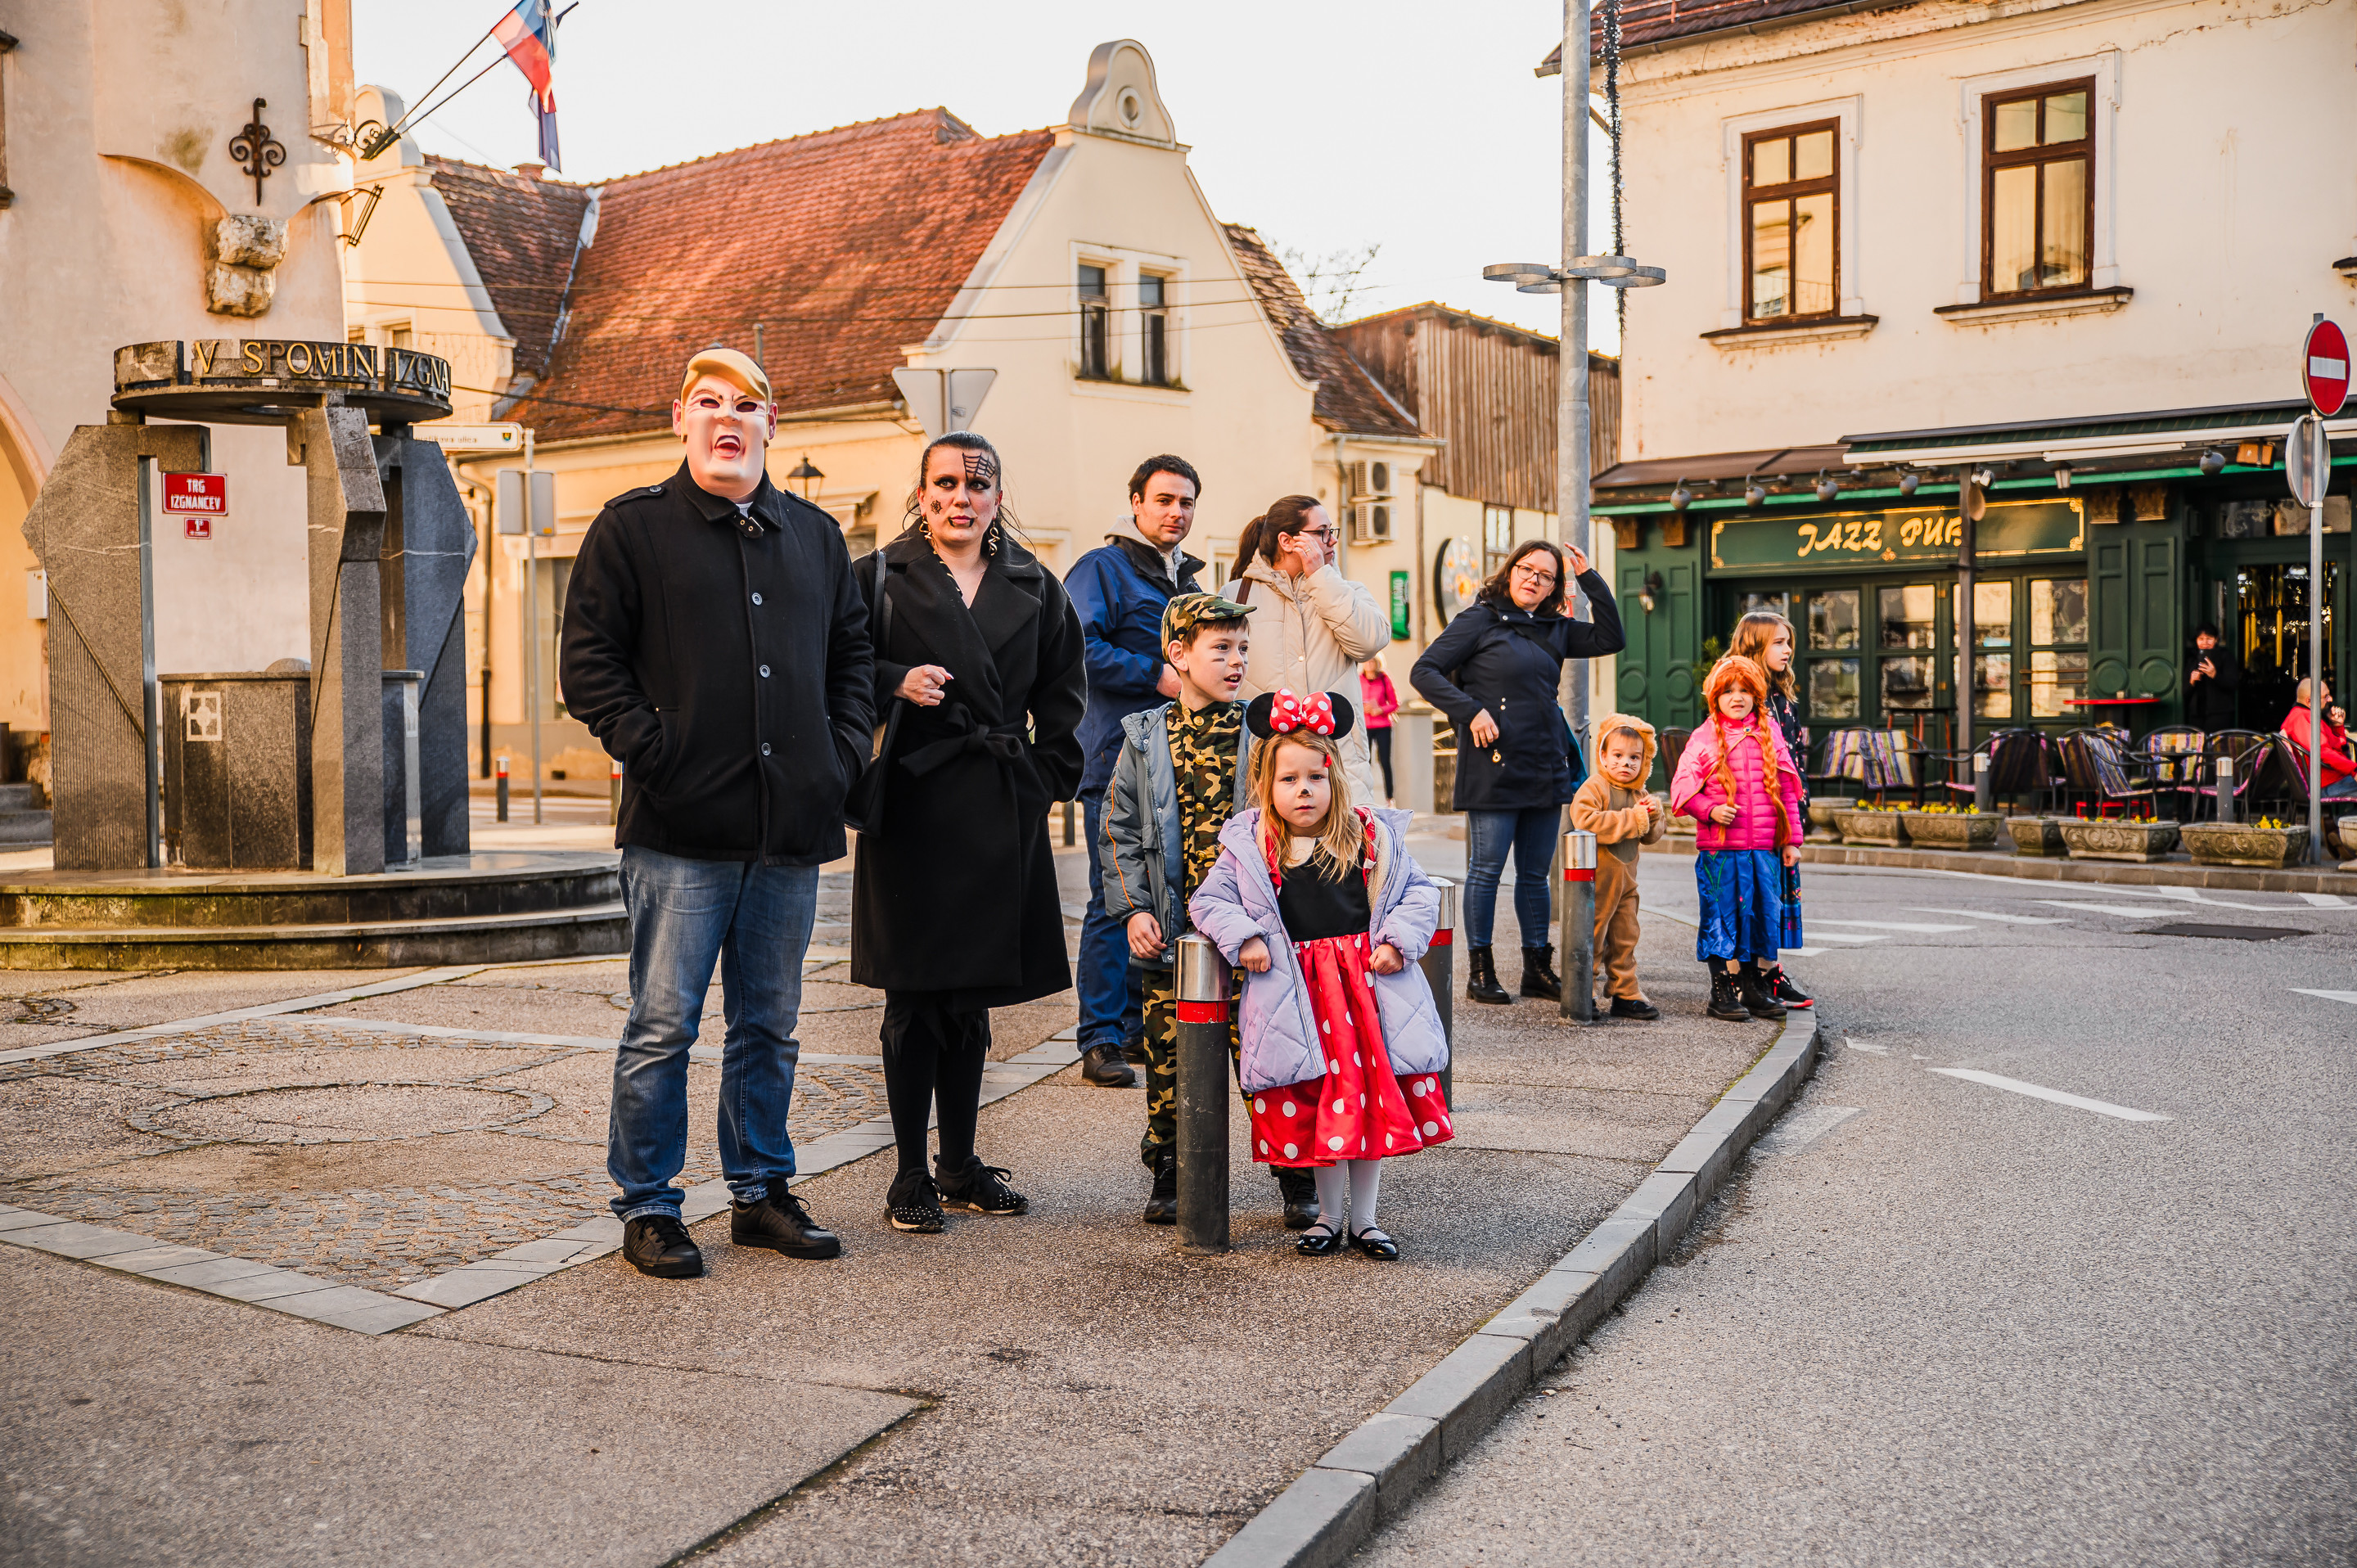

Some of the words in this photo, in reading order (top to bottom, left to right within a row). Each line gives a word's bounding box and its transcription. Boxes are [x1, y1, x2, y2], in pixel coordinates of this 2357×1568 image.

[195, 341, 219, 373] V
[243, 341, 376, 379] SPOMIN
[187, 478, 205, 493] TRG
[171, 494, 221, 510] IZGNANCEV
[1797, 520, 1883, 557] JAZZ
[1900, 516, 1963, 547] PUB
